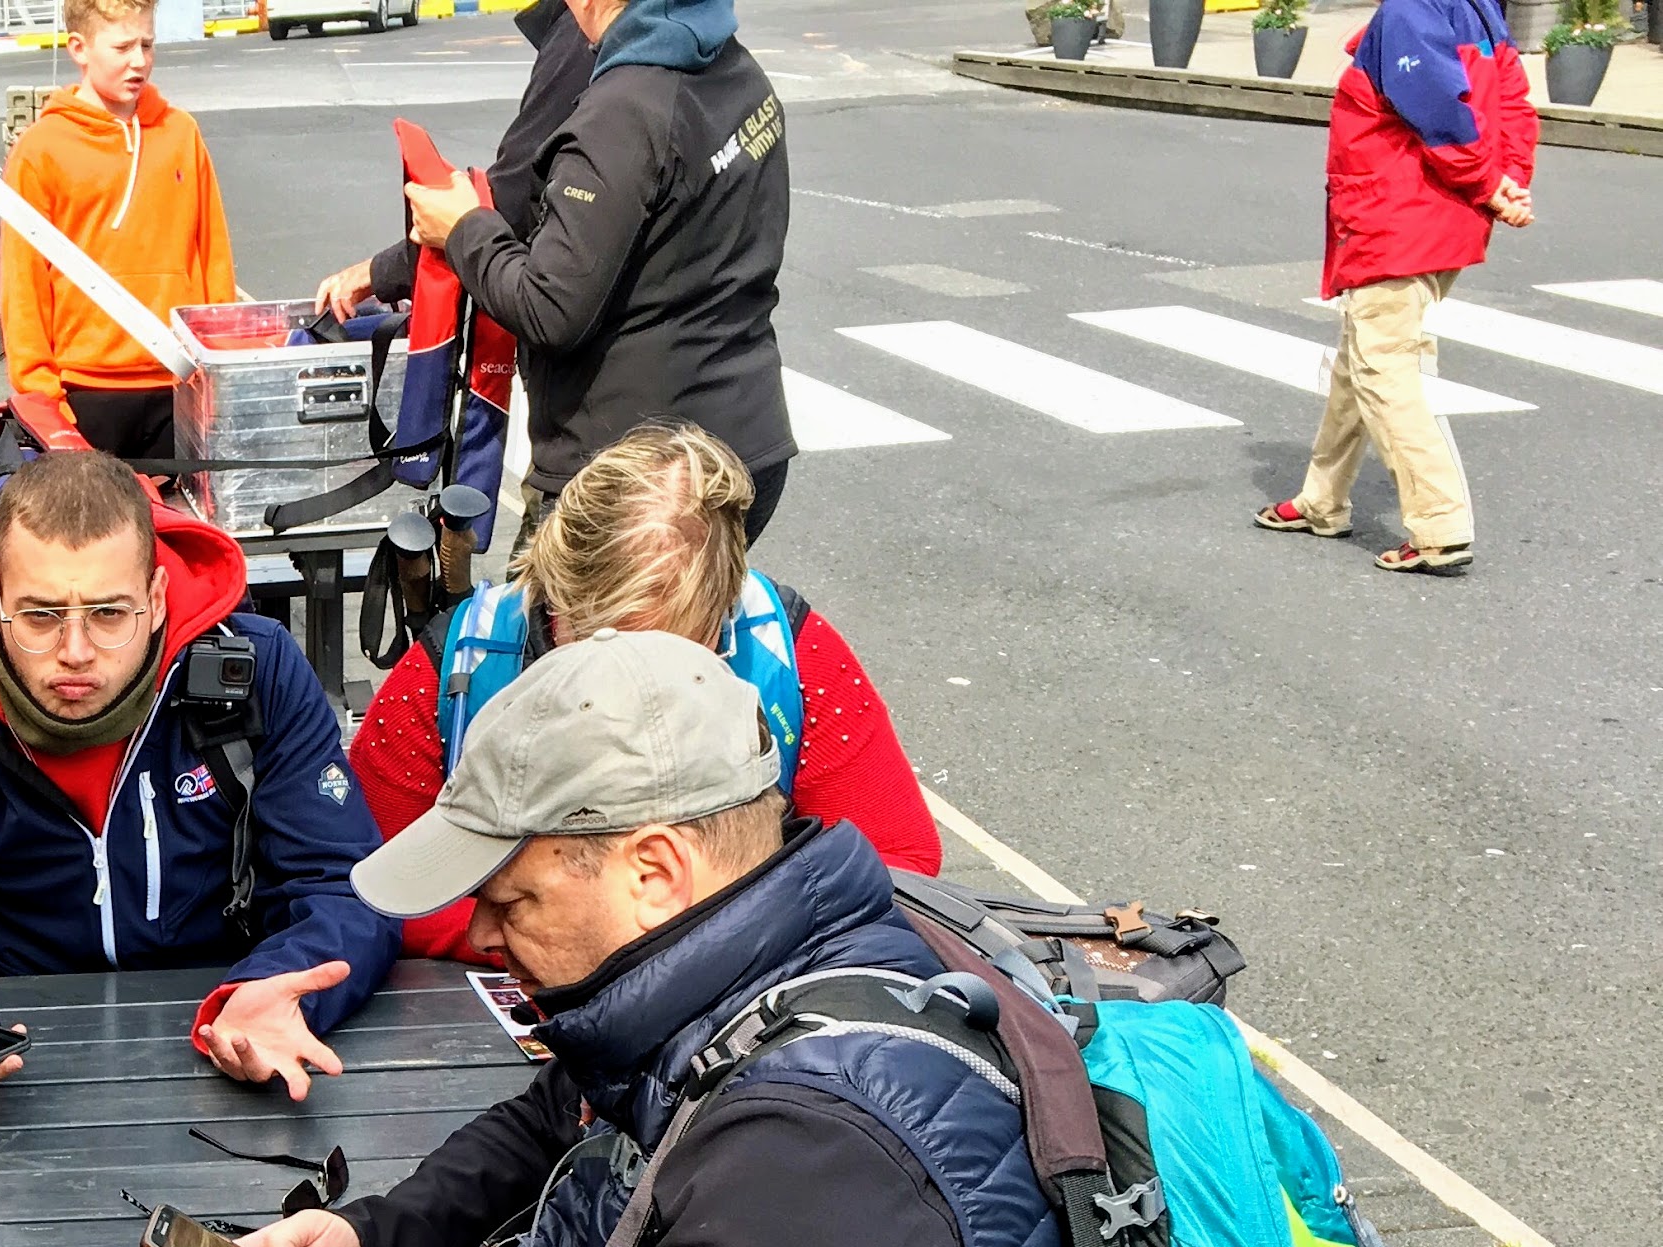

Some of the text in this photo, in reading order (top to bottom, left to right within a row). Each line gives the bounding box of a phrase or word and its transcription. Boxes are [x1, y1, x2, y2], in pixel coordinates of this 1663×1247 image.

[738, 127, 749, 147] A
[745, 127, 776, 161] WITH
[563, 185, 596, 203] CREW
[561, 816, 607, 827] OUTDOOR
